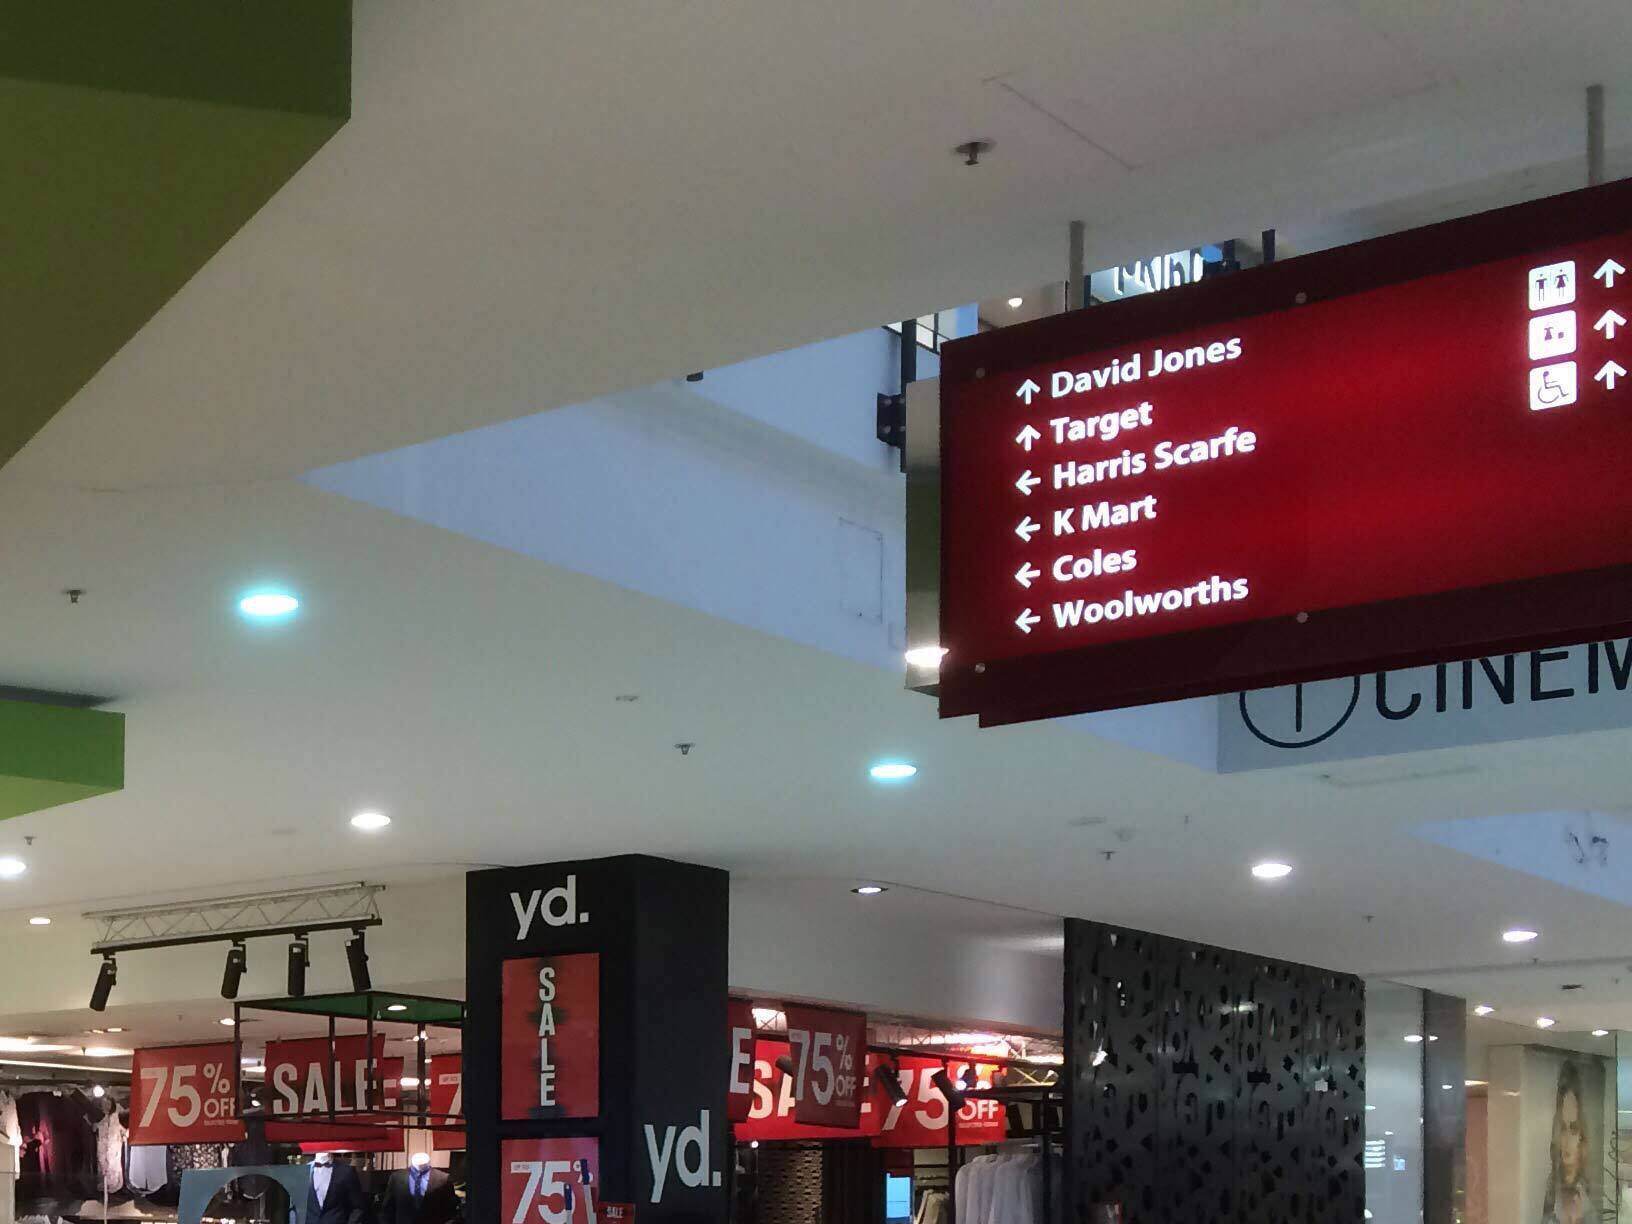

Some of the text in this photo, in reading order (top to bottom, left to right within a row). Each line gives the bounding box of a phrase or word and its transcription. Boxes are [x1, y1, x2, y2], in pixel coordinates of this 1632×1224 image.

[1050, 336, 1243, 399] David Jones
[1050, 401, 1153, 446] Target
[1053, 425, 1257, 490] Harris Scarfe
[1053, 493, 1158, 537] K Mart
[1052, 547, 1138, 583] Coles
[1052, 573, 1250, 630] Woolworths
[509, 874, 589, 941] yd.
[539, 966, 556, 1107] SALE
[272, 1056, 378, 1115] SALE
[834, 1076, 857, 1098] OFF
[957, 1100, 999, 1121] OFF
[644, 1109, 722, 1204] yd.
